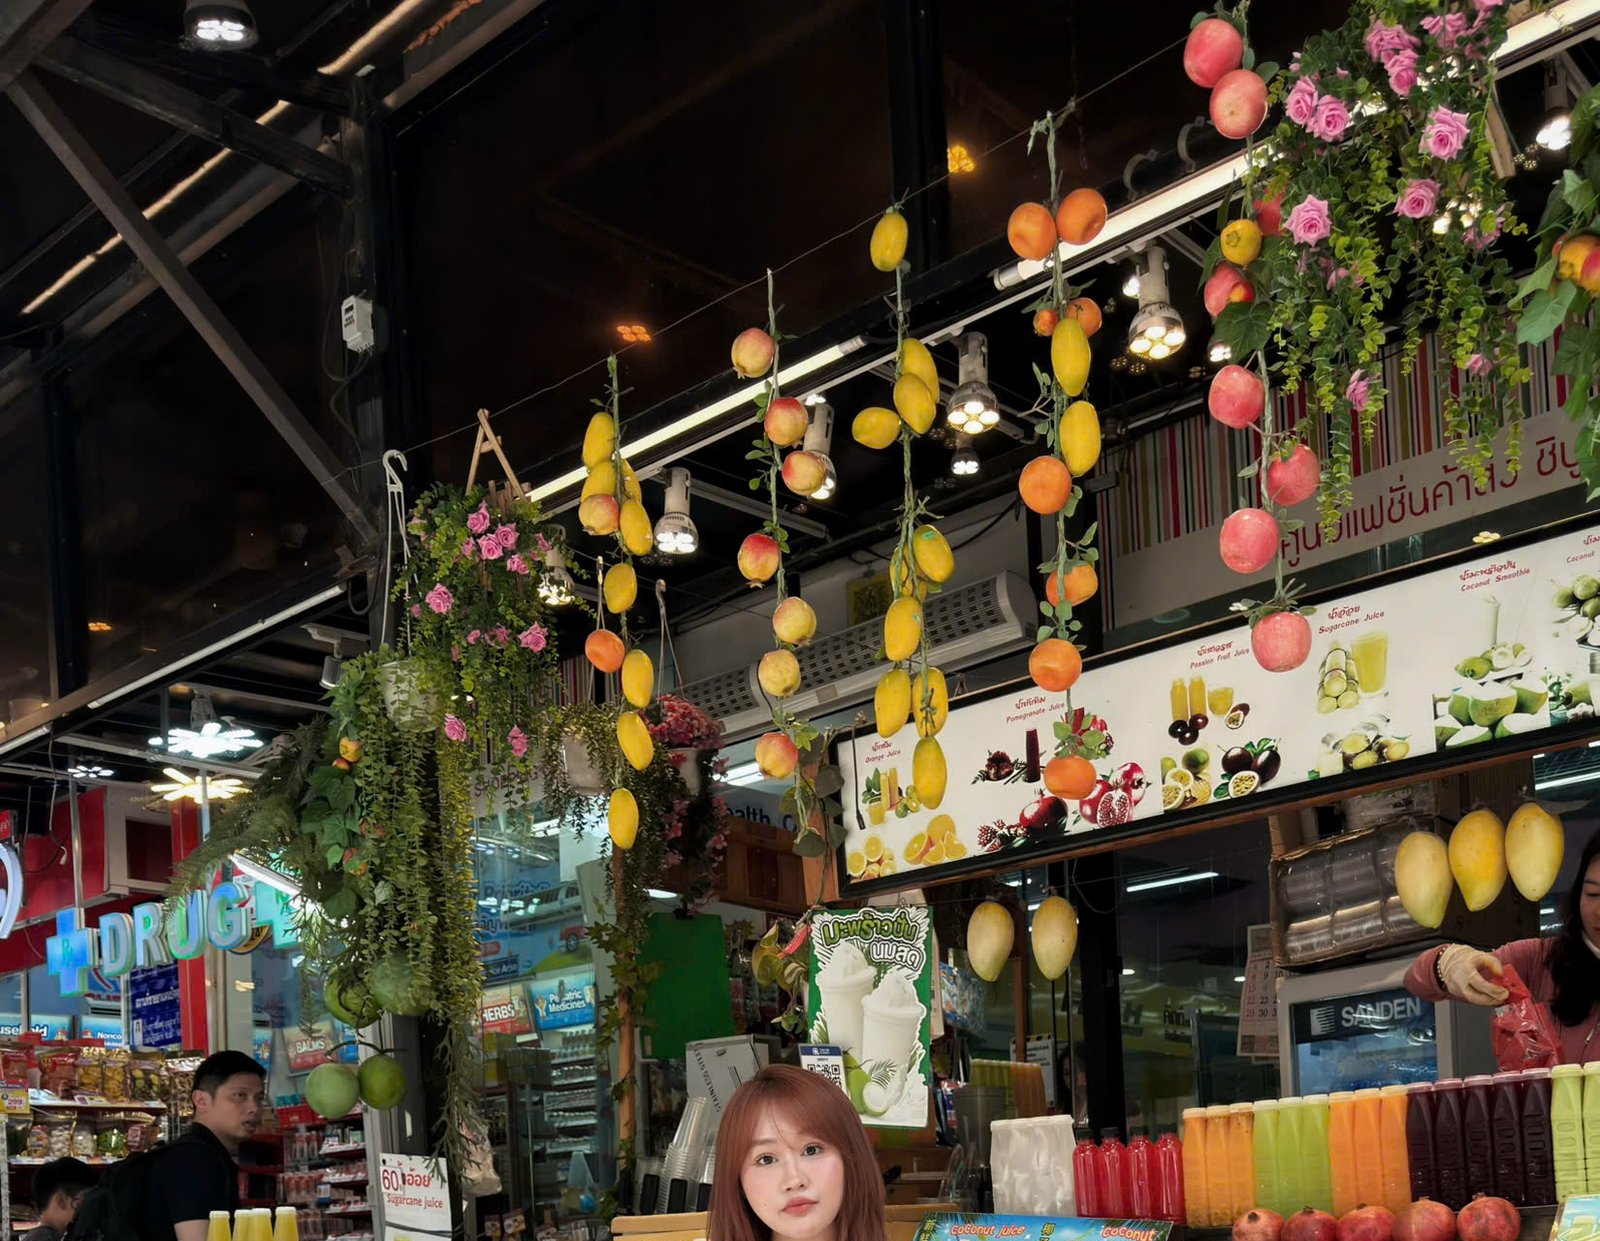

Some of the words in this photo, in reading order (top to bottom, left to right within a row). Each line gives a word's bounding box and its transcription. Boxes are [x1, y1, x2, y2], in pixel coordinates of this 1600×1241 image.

[1461, 579, 1490, 591] Coconut
[1495, 568, 1530, 582] Smoothie
[1319, 617, 1360, 634] Sugarcane
[1364, 611, 1385, 622] Juice
[1006, 708, 1045, 723] Pomegranate
[1049, 702, 1065, 712] Juice
[865, 754, 884, 763] Orange
[99, 881, 247, 977] DRUG
[821, 911, 919, 945] มะพร้าวปั่น
[872, 941, 923, 971] นมสด
[549, 989, 582, 1001] Peatric
[549, 1000, 586, 1012] Medicines
[1341, 997, 1421, 1028] SANDEN
[296, 1039, 325, 1053] BALMS
[382, 1169, 399, 1191] 60
[387, 1194, 423, 1206] Sugarcane
[424, 1196, 443, 1209] juice
[995, 1225, 1026, 1239] juice
